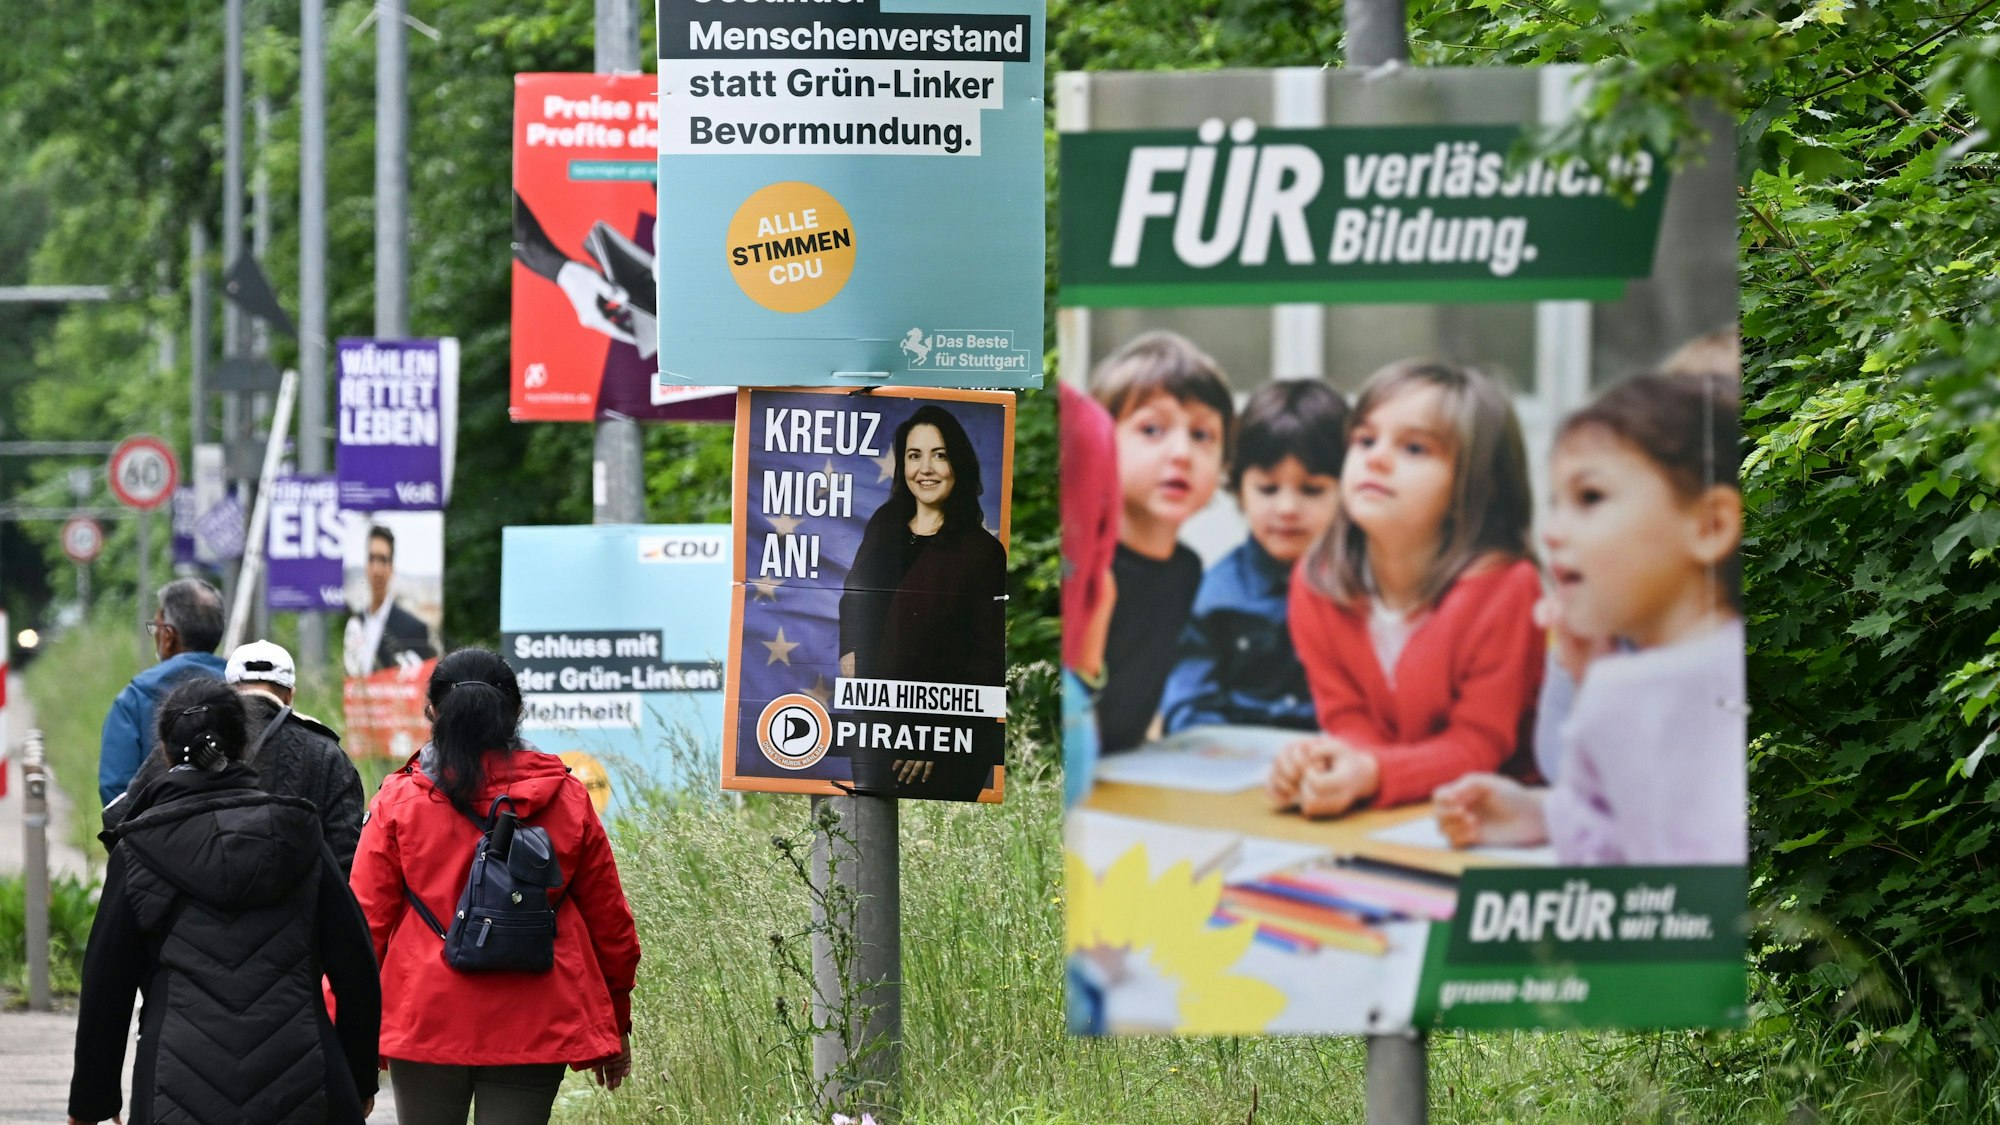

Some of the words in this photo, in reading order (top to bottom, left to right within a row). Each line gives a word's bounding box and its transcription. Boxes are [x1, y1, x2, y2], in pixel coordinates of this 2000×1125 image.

[689, 20, 1023, 53] Menschenverstand
[689, 70, 777, 97] statt
[786, 67, 995, 99] Grün-Linker
[543, 94, 632, 120] Preise
[526, 122, 625, 148] Profite
[628, 123, 658, 148] de
[689, 116, 972, 153] Bevormundung.
[1109, 117, 1324, 268] FÜR
[758, 208, 819, 238] ALLE
[732, 228, 851, 266] STIMMEN
[1329, 205, 1539, 276] Bildung.
[768, 258, 823, 285] CDU
[936, 334, 963, 348] Das
[967, 334, 1009, 348] Beste
[340, 343, 438, 376] WÄHLEN
[935, 352, 956, 367] für
[959, 353, 1025, 371] Stuttgart
[340, 378, 436, 407] RETTET
[340, 407, 438, 446] LEBEN
[764, 407, 881, 456] KREUZ
[125, 456, 162, 489] 60
[394, 481, 438, 504] Volt
[762, 470, 853, 518] MICH
[268, 502, 346, 560] EIS
[662, 541, 720, 557] CDU
[760, 533, 820, 579] AN!
[514, 635, 610, 658] Schluss
[615, 632, 658, 658] mit
[517, 668, 558, 691] der
[559, 665, 720, 690] Grün-Linken
[841, 682, 890, 708] ANJA
[896, 685, 984, 713] HIRSCHEL
[836, 721, 973, 753] PIRATEN
[1468, 878, 1617, 943] DAFÜR
[1623, 884, 1678, 913] sind
[1618, 915, 1660, 940] wir
[1661, 909, 1715, 940] hier.
